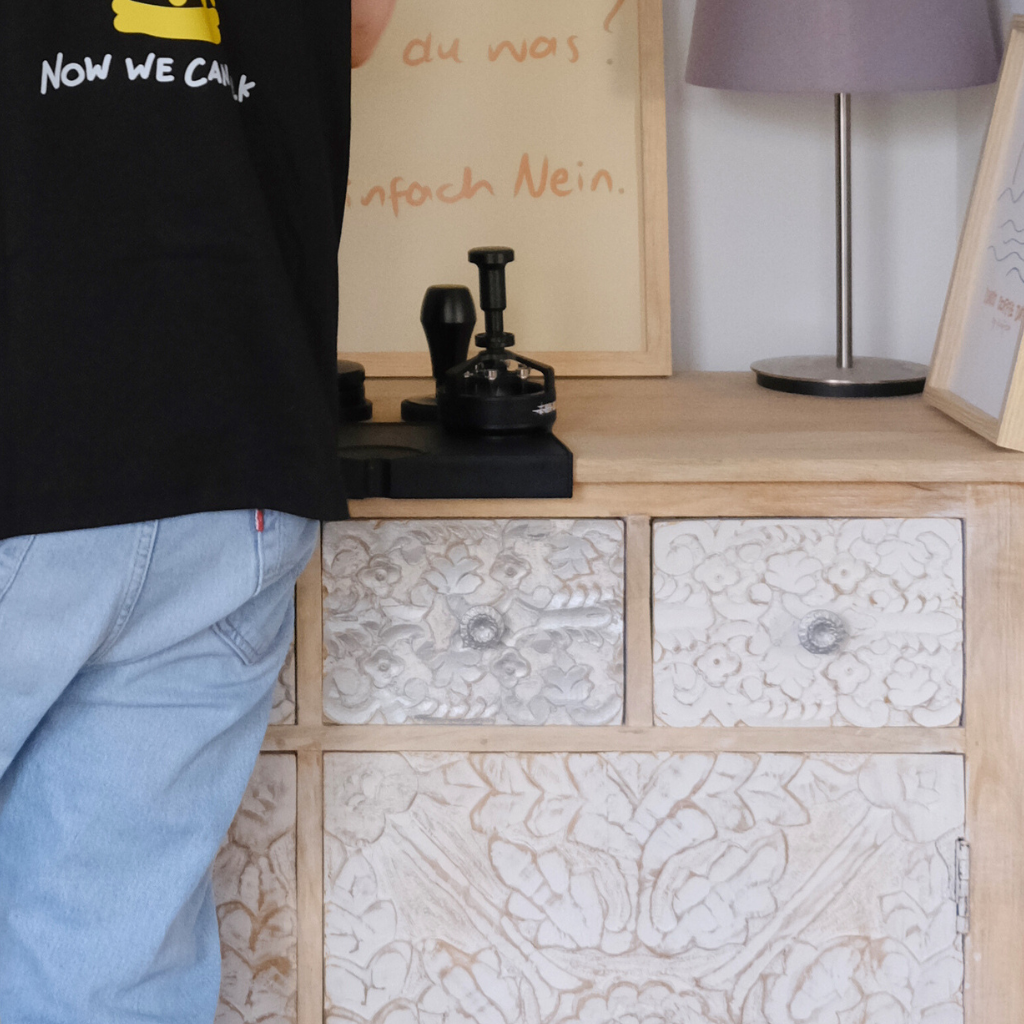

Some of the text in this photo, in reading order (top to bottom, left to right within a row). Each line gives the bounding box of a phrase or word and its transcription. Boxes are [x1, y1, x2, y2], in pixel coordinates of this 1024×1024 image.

[402, 32, 462, 67] du
[40, 52, 113, 95] NOW
[125, 52, 175, 82] WE
[514, 153, 626, 199] Nein.
